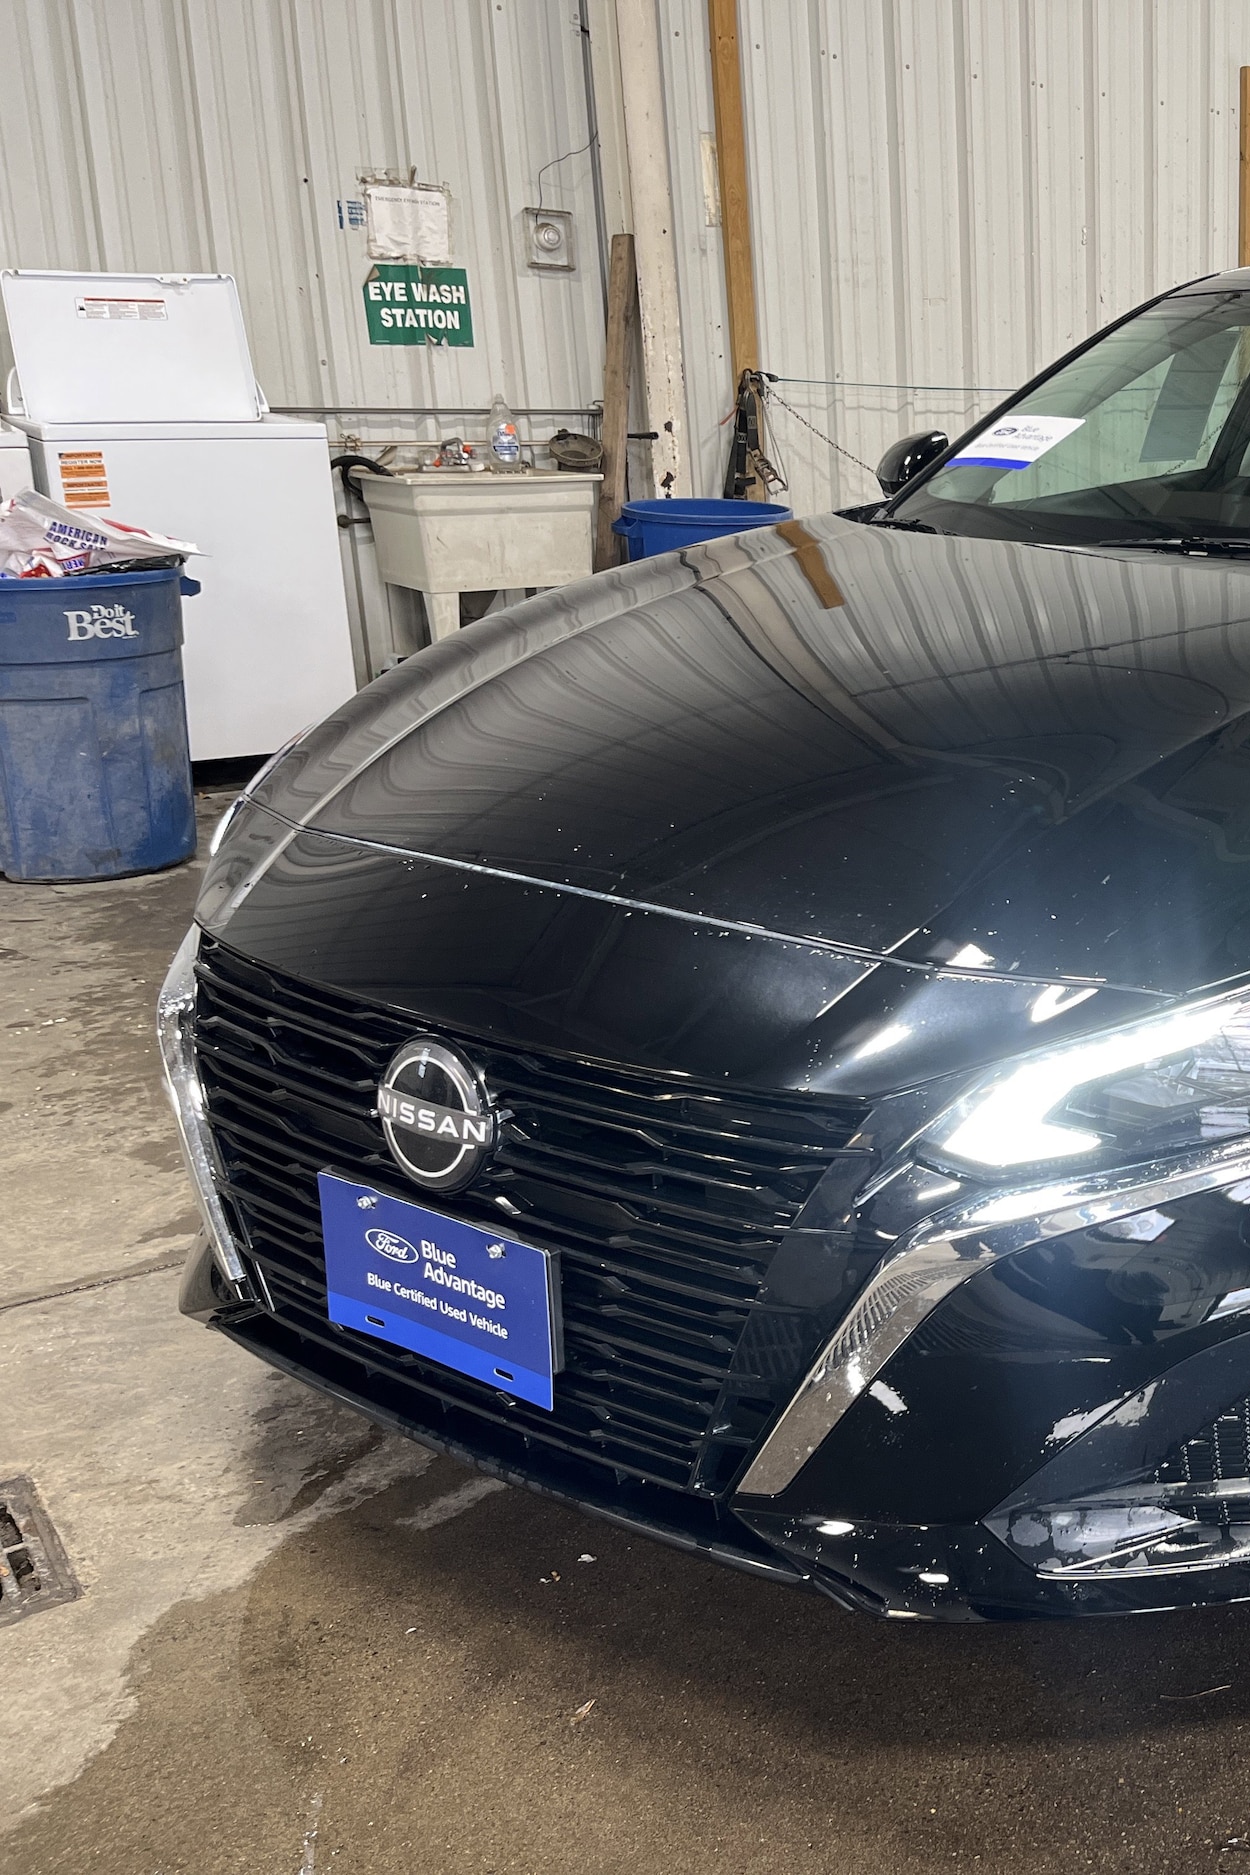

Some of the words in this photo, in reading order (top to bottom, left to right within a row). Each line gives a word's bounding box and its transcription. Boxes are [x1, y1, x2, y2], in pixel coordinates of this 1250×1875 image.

[368, 281, 408, 301] EYE
[411, 283, 466, 304] WASH
[380, 308, 460, 329] STATION
[49, 521, 108, 546] AMERICAN
[62, 610, 139, 640] Best
[90, 604, 115, 619] Do
[113, 604, 126, 617] it
[377, 1088, 486, 1144] NISSAN
[421, 1239, 457, 1269] Blue
[424, 1262, 506, 1309] Advantage
[367, 1272, 392, 1292] Blue
[393, 1282, 438, 1310] Certified
[439, 1300, 467, 1323] Used
[469, 1312, 508, 1339] Vehicle
